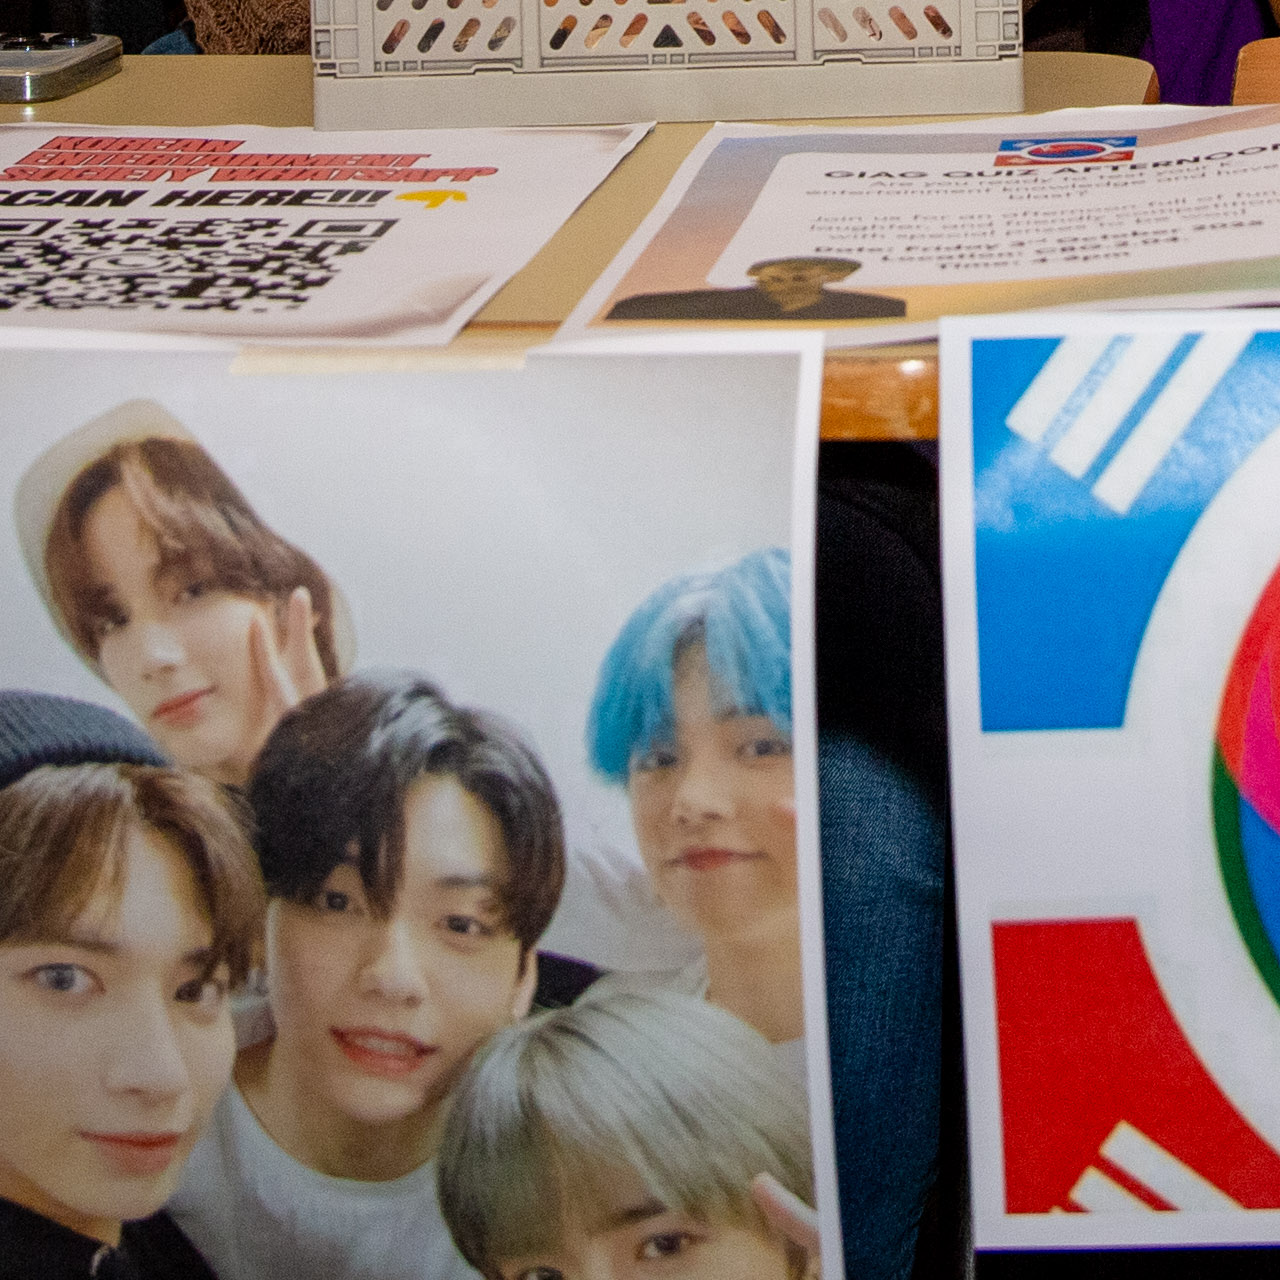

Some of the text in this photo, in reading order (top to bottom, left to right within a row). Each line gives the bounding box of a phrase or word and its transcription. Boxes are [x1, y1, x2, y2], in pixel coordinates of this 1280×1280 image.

[38, 135, 246, 153] KOREAN
[15, 150, 432, 168] ENTERTAINMENT
[0, 166, 498, 183] SOCIETY WHATSAPP
[943, 168, 1039, 179] QUIZ
[151, 189, 392, 208] HERE!!!
